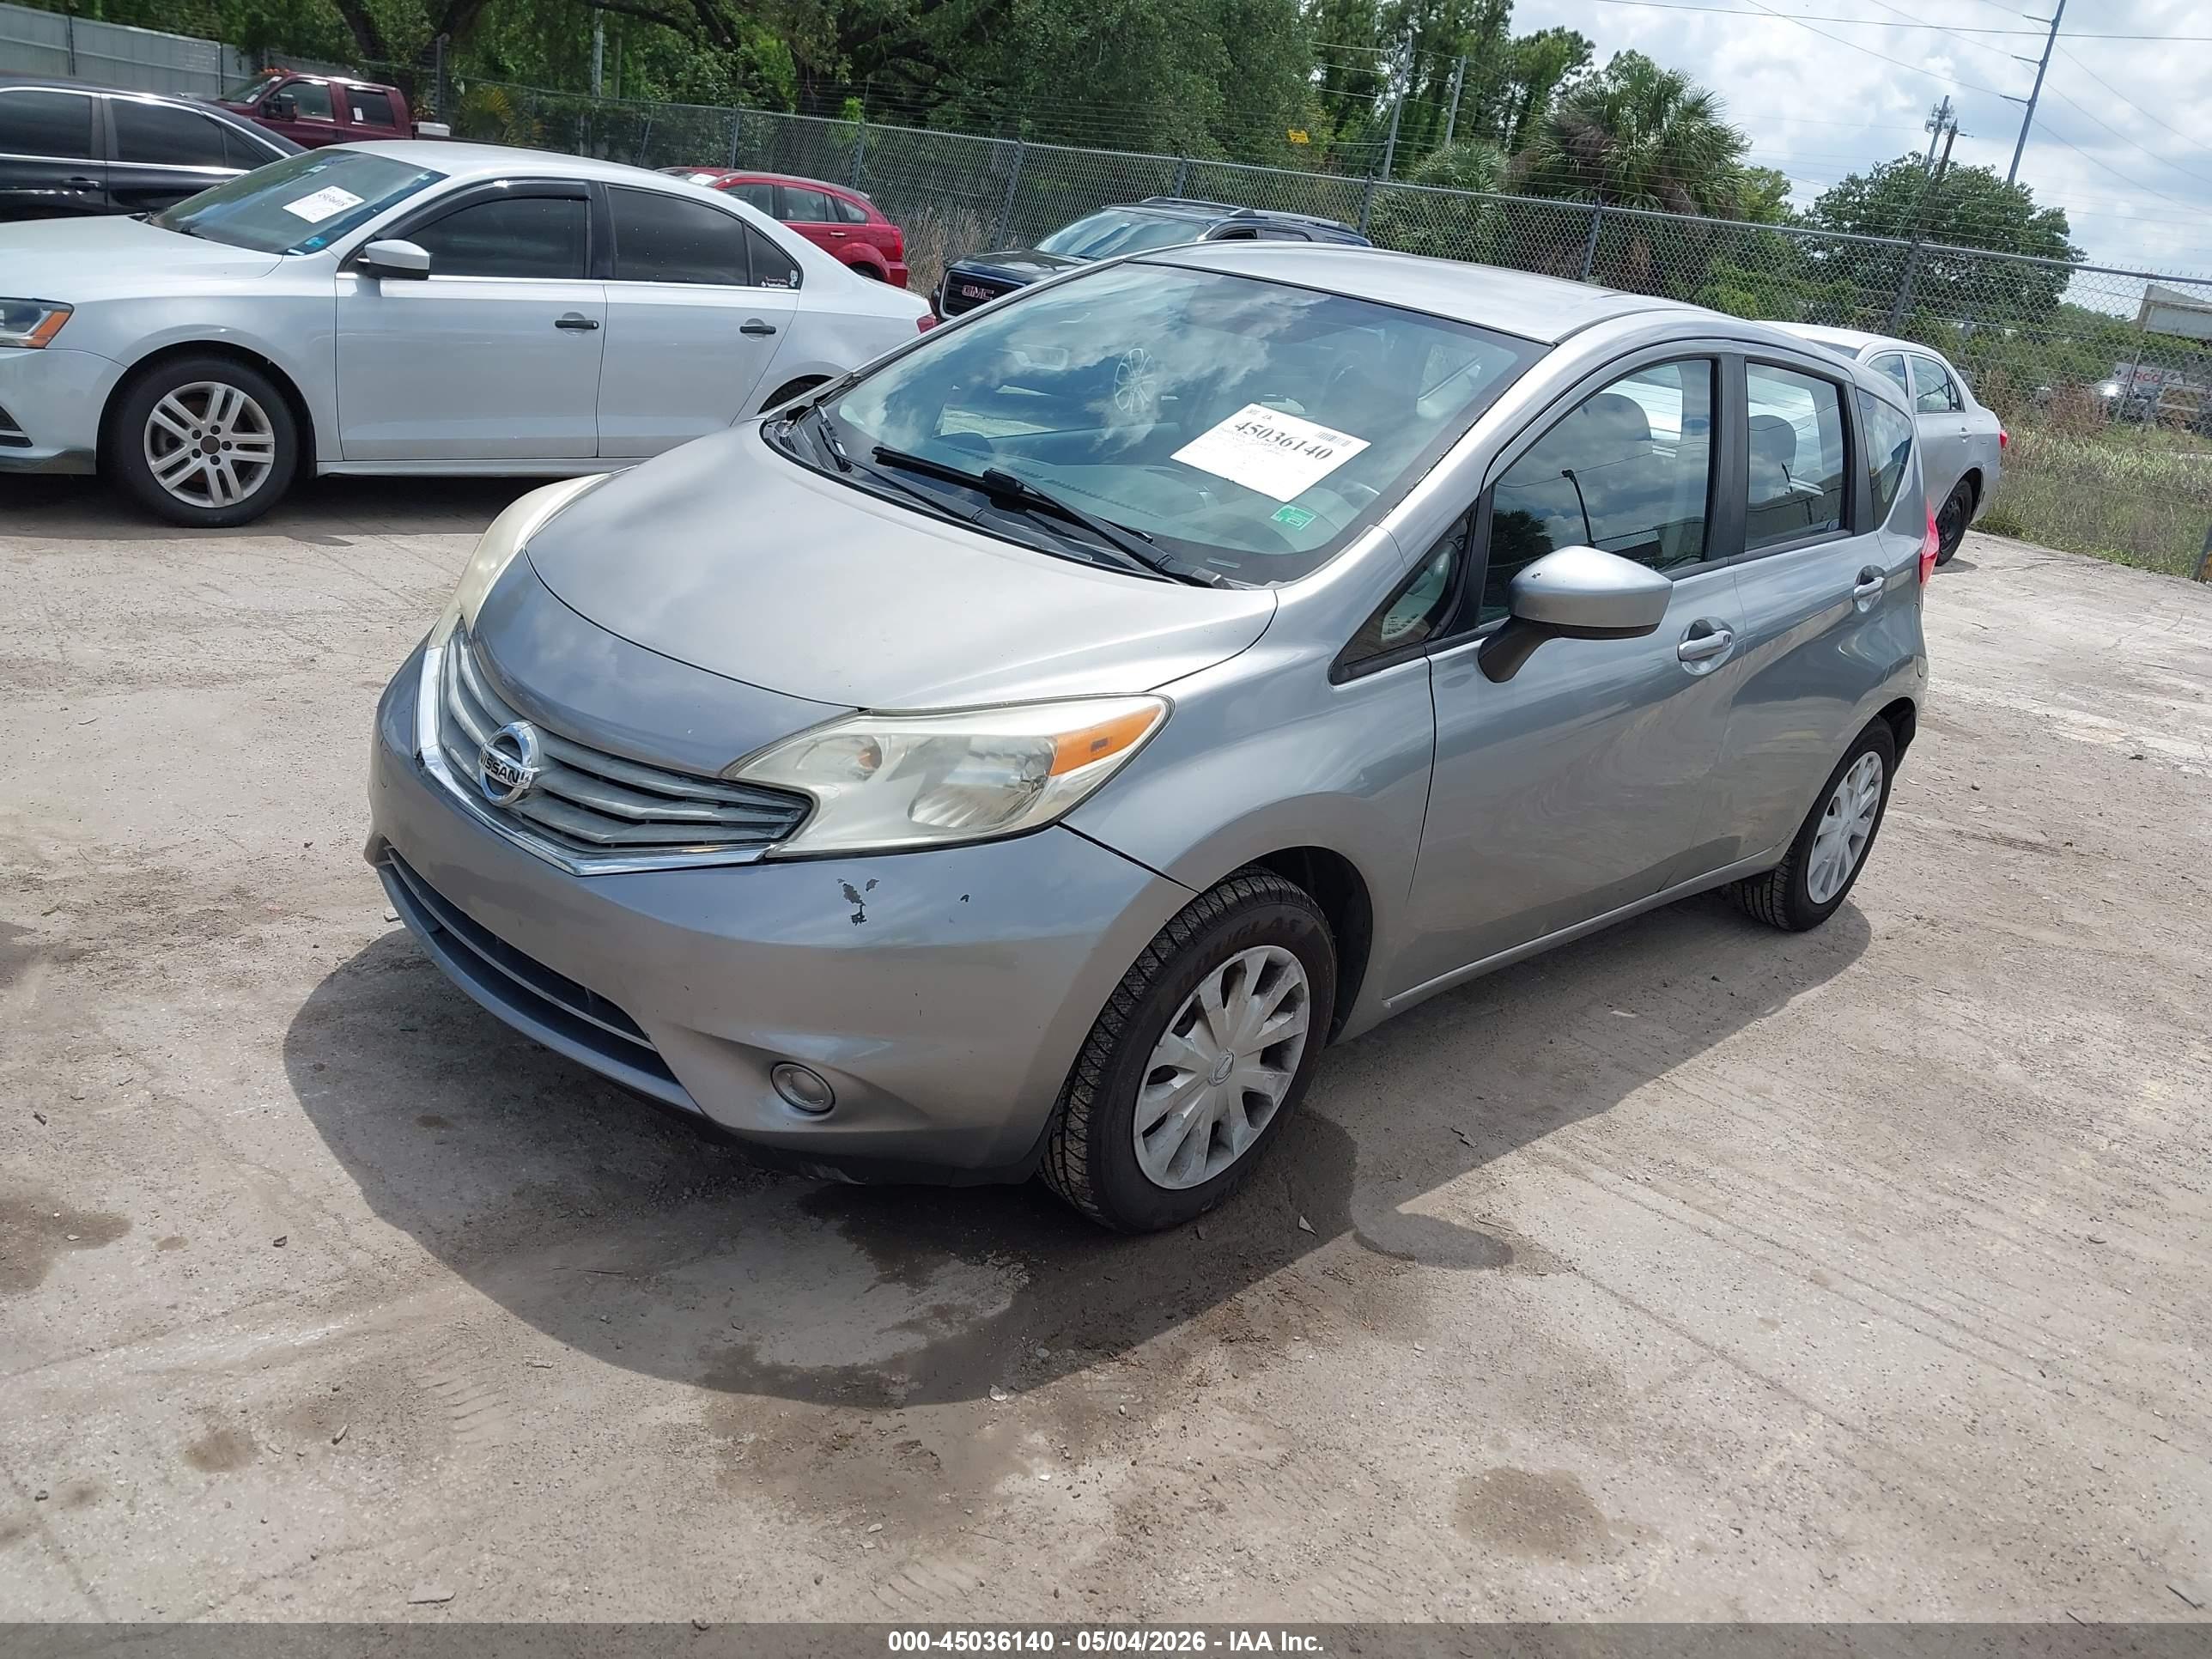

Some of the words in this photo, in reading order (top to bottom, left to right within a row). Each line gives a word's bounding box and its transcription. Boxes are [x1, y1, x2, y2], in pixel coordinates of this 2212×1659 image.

[962, 285, 994, 301] GMC
[1234, 421, 1334, 460] 45036140
[480, 748, 520, 783] NISSAN
